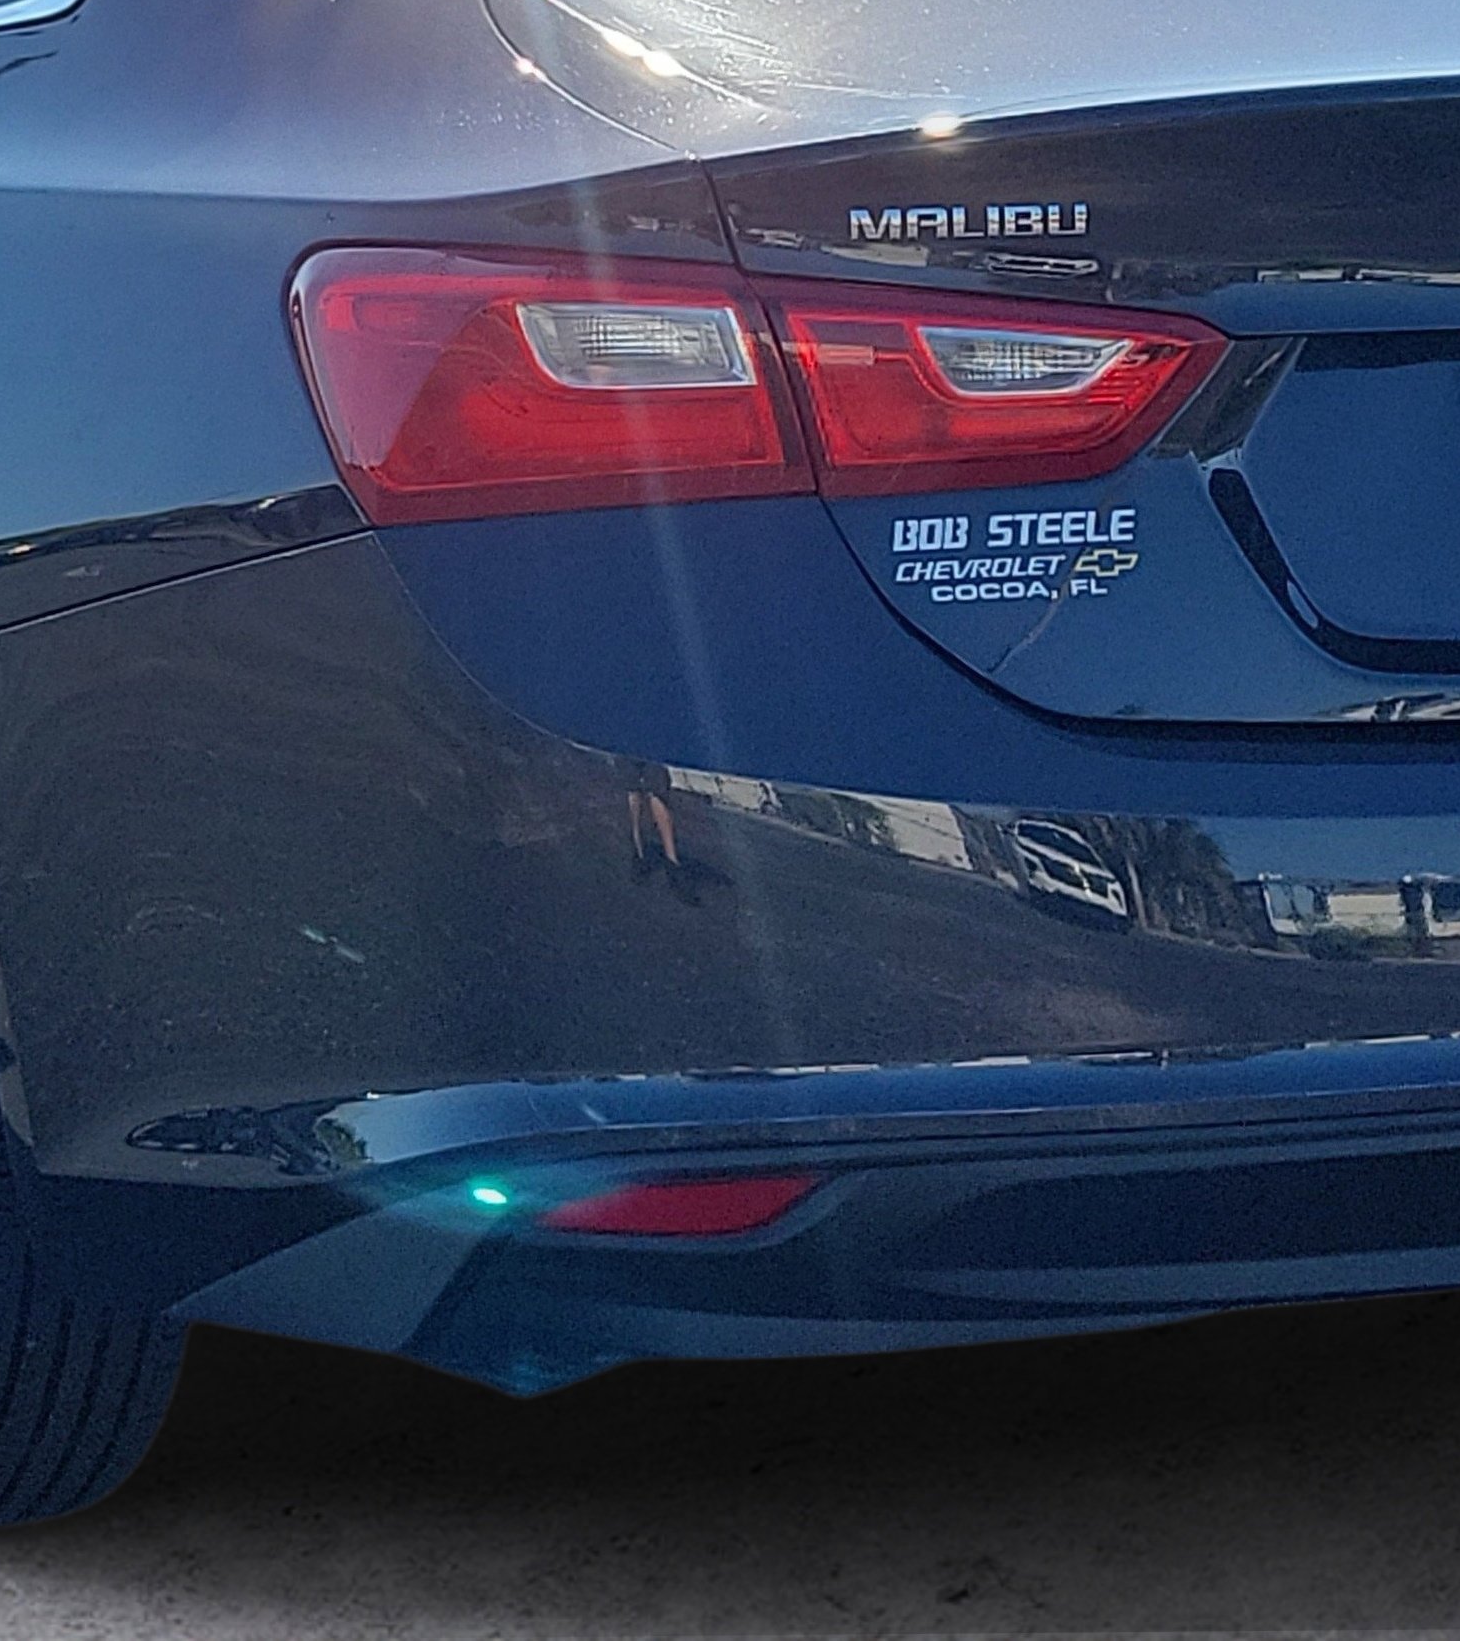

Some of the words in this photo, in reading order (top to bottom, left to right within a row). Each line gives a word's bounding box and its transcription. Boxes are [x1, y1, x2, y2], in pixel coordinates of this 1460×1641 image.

[848, 202, 1089, 242] MALIBU
[892, 516, 970, 553] BOB
[986, 508, 1137, 547] STEELE
[895, 553, 1066, 583] CHEVROLET
[930, 580, 1062, 603] COCOA,
[1070, 577, 1109, 598] FL
